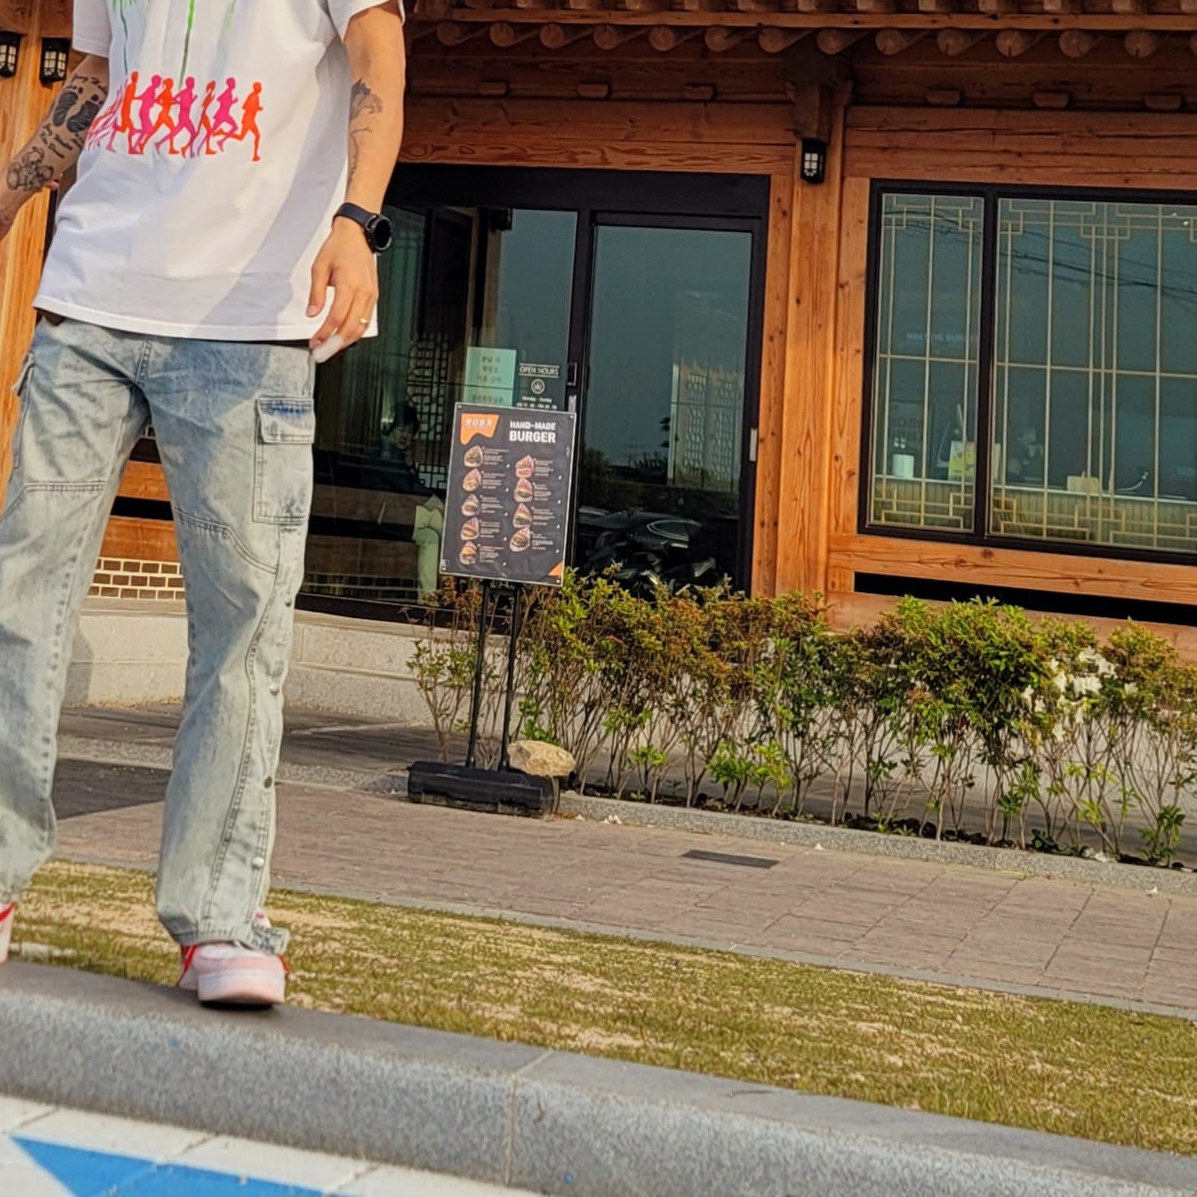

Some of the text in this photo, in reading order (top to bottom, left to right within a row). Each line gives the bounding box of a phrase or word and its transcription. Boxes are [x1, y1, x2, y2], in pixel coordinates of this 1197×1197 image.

[519, 365, 559, 375] OPEN HOURS
[509, 419, 557, 431] HAND-MADE
[508, 430, 557, 444] BURGER
